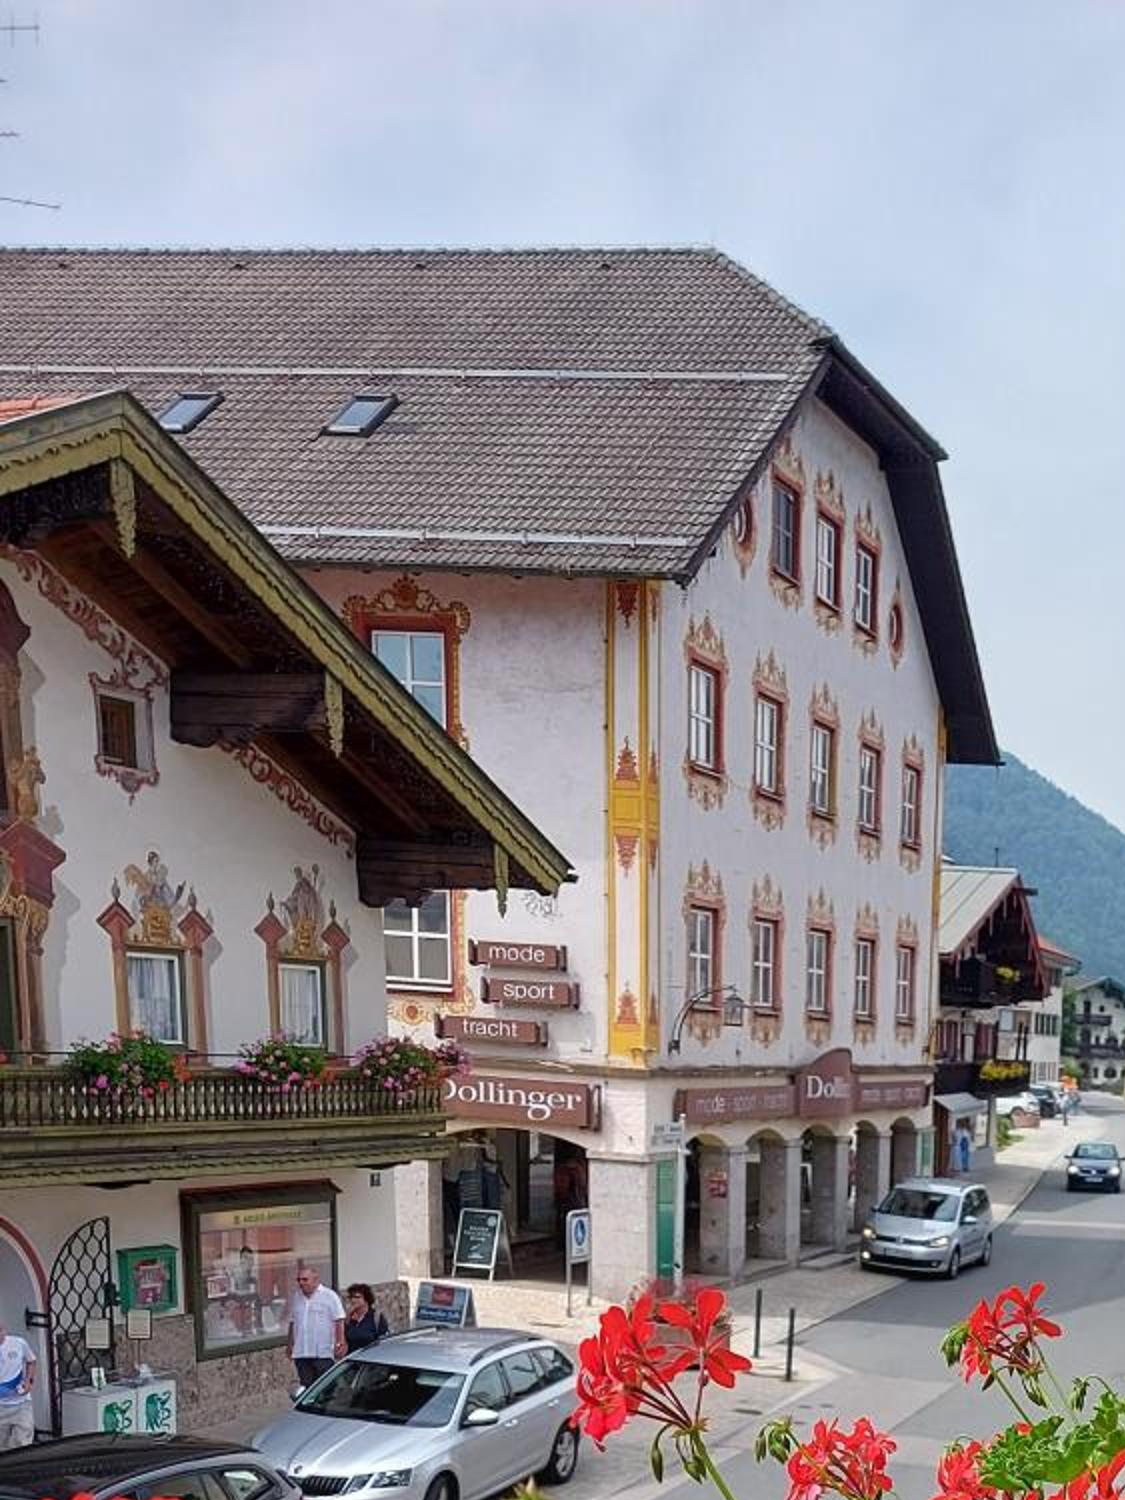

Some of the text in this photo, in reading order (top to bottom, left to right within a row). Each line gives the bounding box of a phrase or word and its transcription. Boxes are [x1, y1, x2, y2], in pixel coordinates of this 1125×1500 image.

[488, 945, 545, 963] mode
[503, 983, 554, 1001] sport
[462, 1019, 518, 1038] tracht
